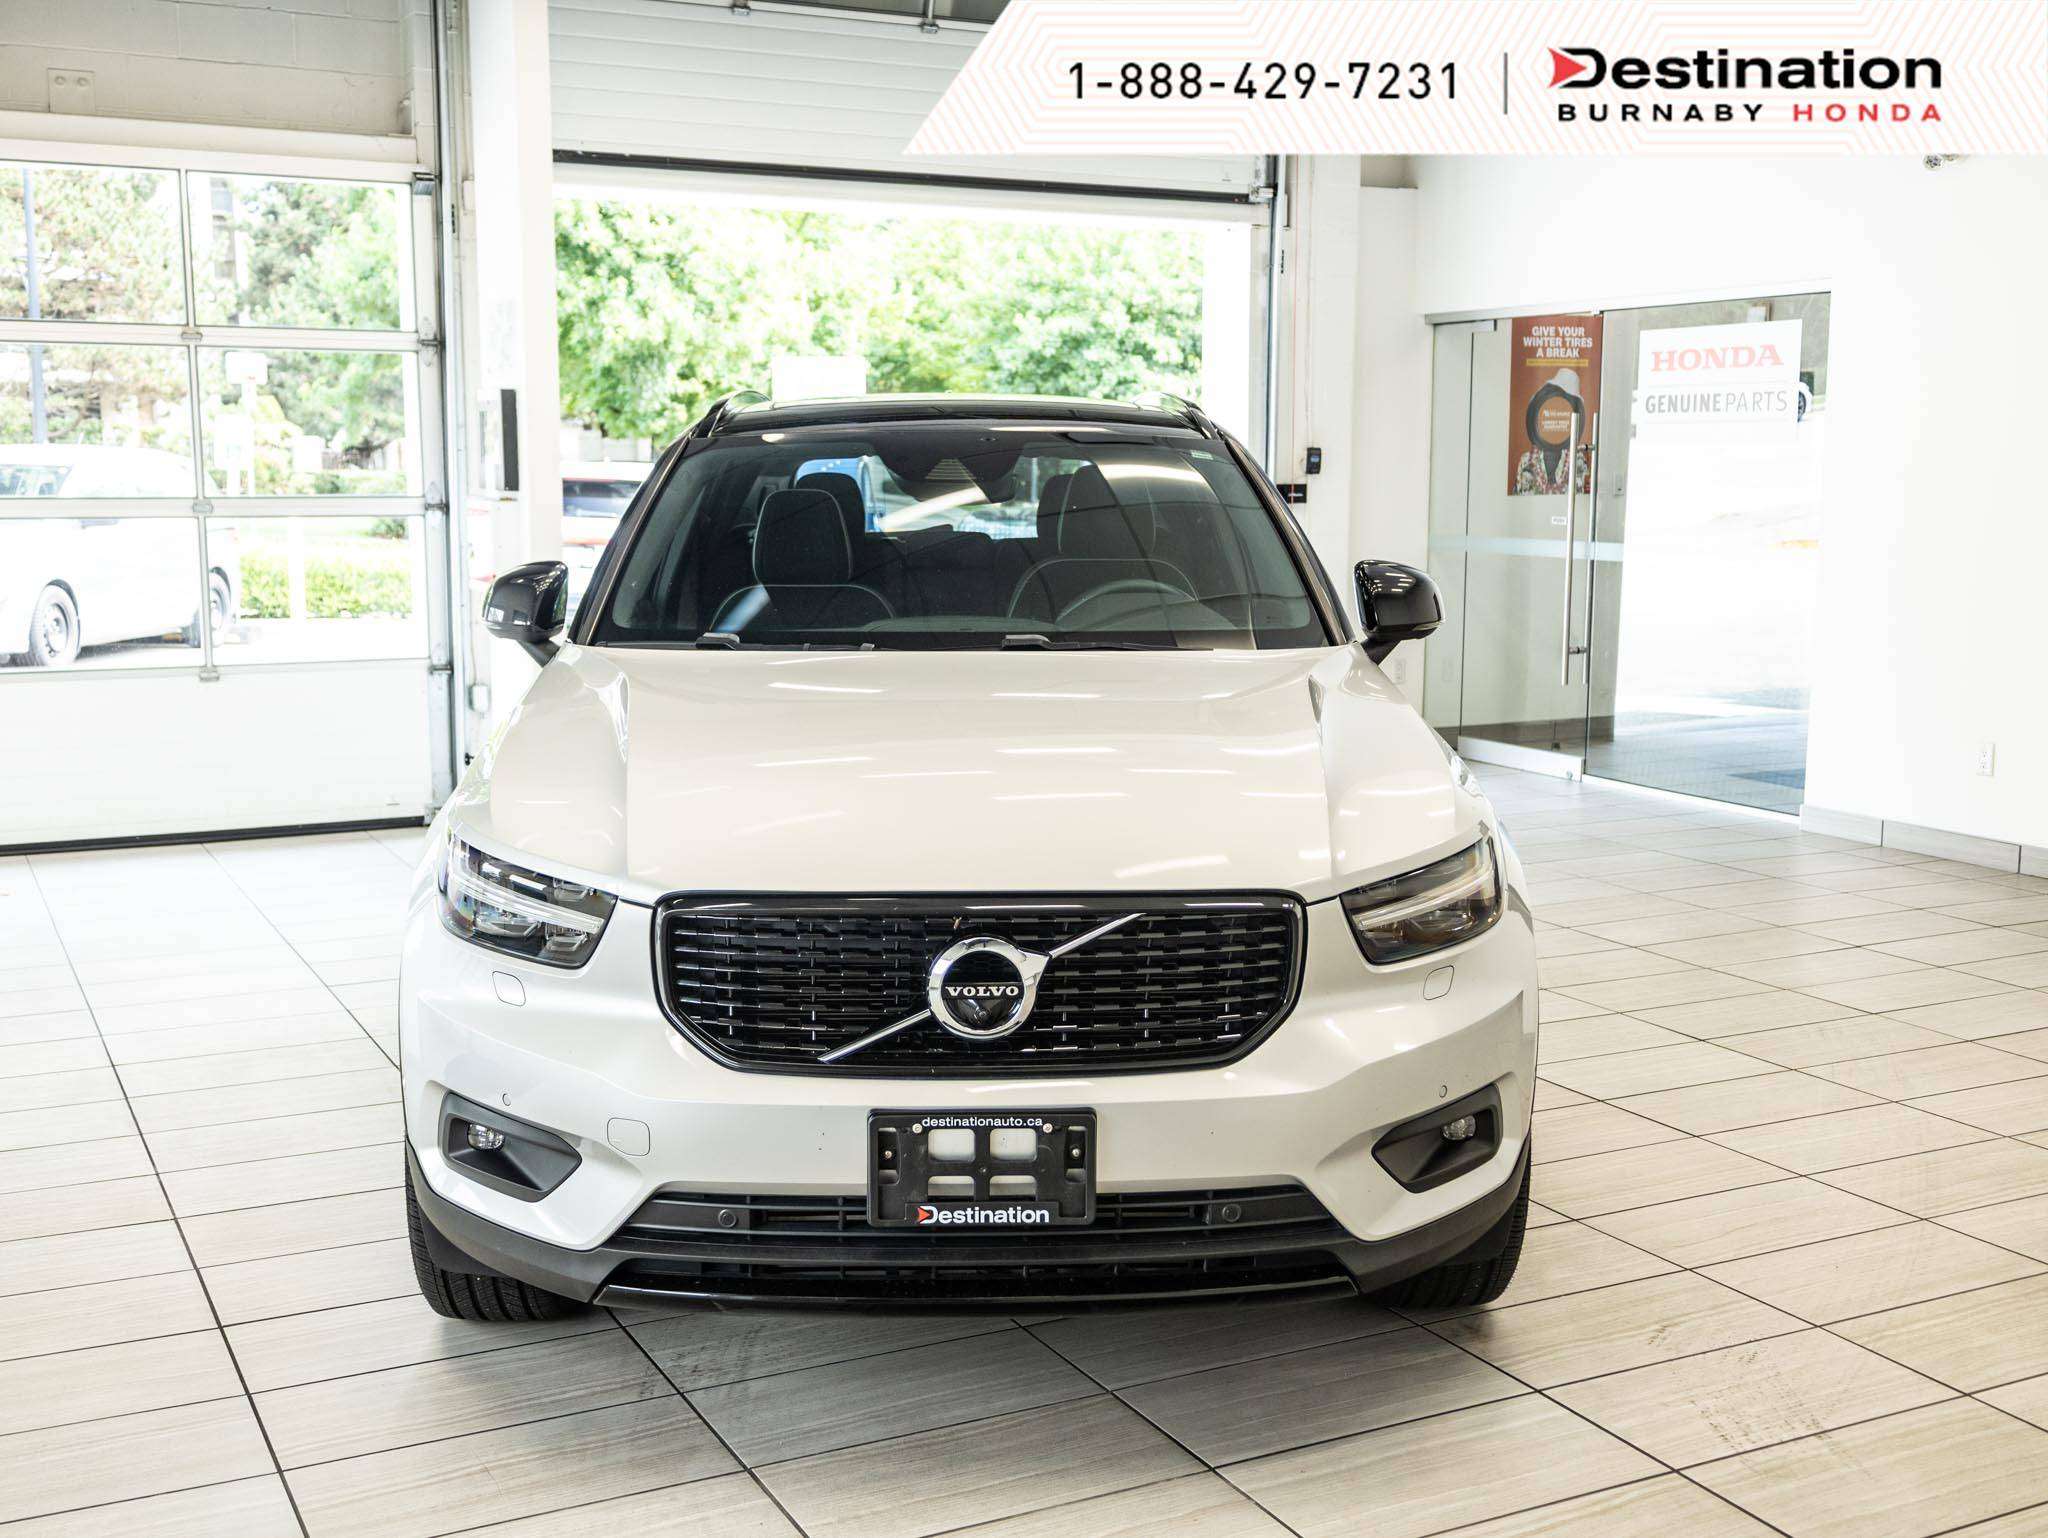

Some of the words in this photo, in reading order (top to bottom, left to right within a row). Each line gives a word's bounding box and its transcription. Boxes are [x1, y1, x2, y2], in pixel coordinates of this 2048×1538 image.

[1532, 326, 1556, 337] GIVE
[1558, 326, 1585, 337] YOUR
[1523, 336, 1562, 347] WINTER
[1565, 337, 1593, 348] TIRES
[1536, 348, 1544, 358] A
[1546, 348, 1580, 358] BREAK
[1651, 344, 1785, 372] HONDA
[945, 986, 1019, 997] VOLVO
[922, 1116, 1044, 1127] destinationauto.ca
[917, 1205, 1051, 1225] Destination
